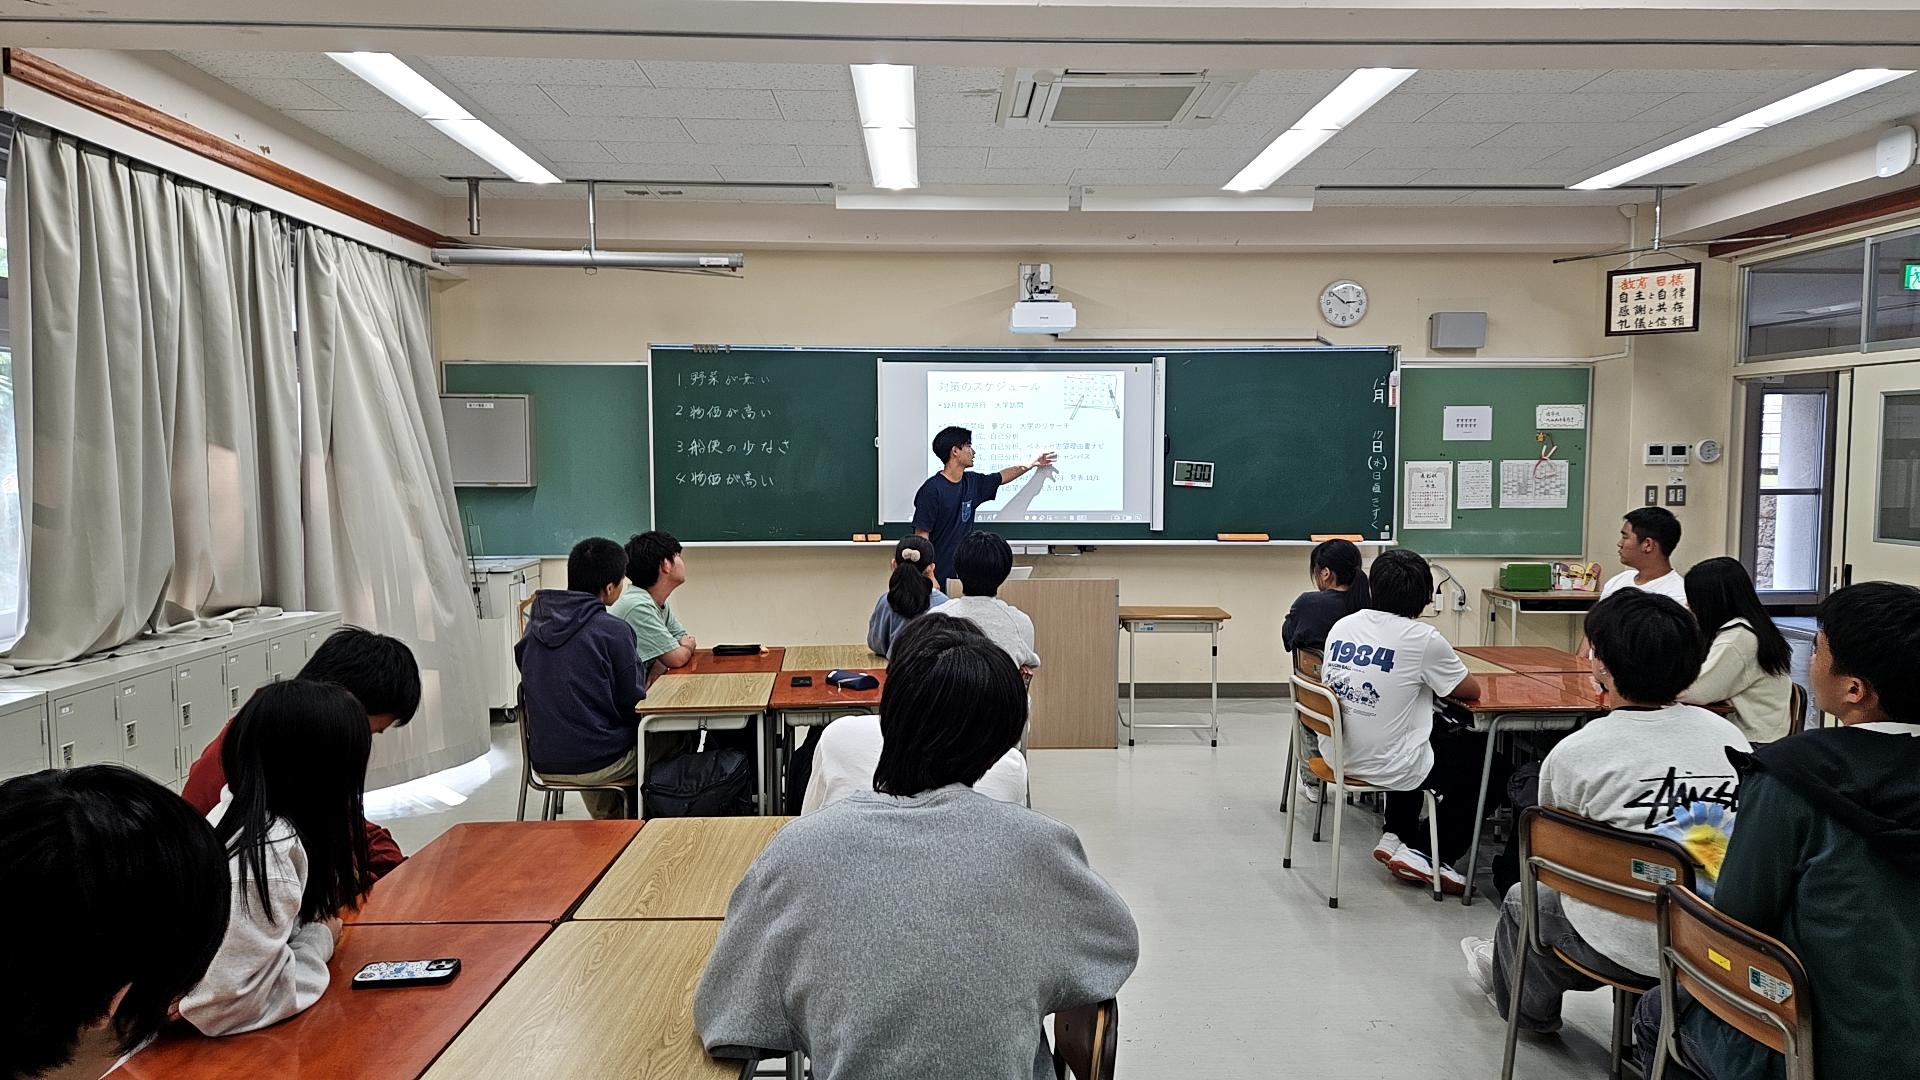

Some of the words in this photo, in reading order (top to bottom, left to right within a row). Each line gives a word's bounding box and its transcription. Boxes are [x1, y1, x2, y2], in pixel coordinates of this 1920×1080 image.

[1619, 276, 1648, 290] 教育
[1656, 273, 1685, 287] 目標
[1619, 287, 1687, 303] 自主と自律
[1618, 301, 1685, 317] 感謝と共存
[1617, 316, 1685, 330] 礼儀と信頼
[938, 381, 1041, 393] 対策のスケジュール
[690, 404, 771, 420] 物価が高い
[688, 439, 789, 456] 船便の少なさ
[691, 470, 774, 488] 物価が高い
[1330, 640, 1395, 673] 1984
